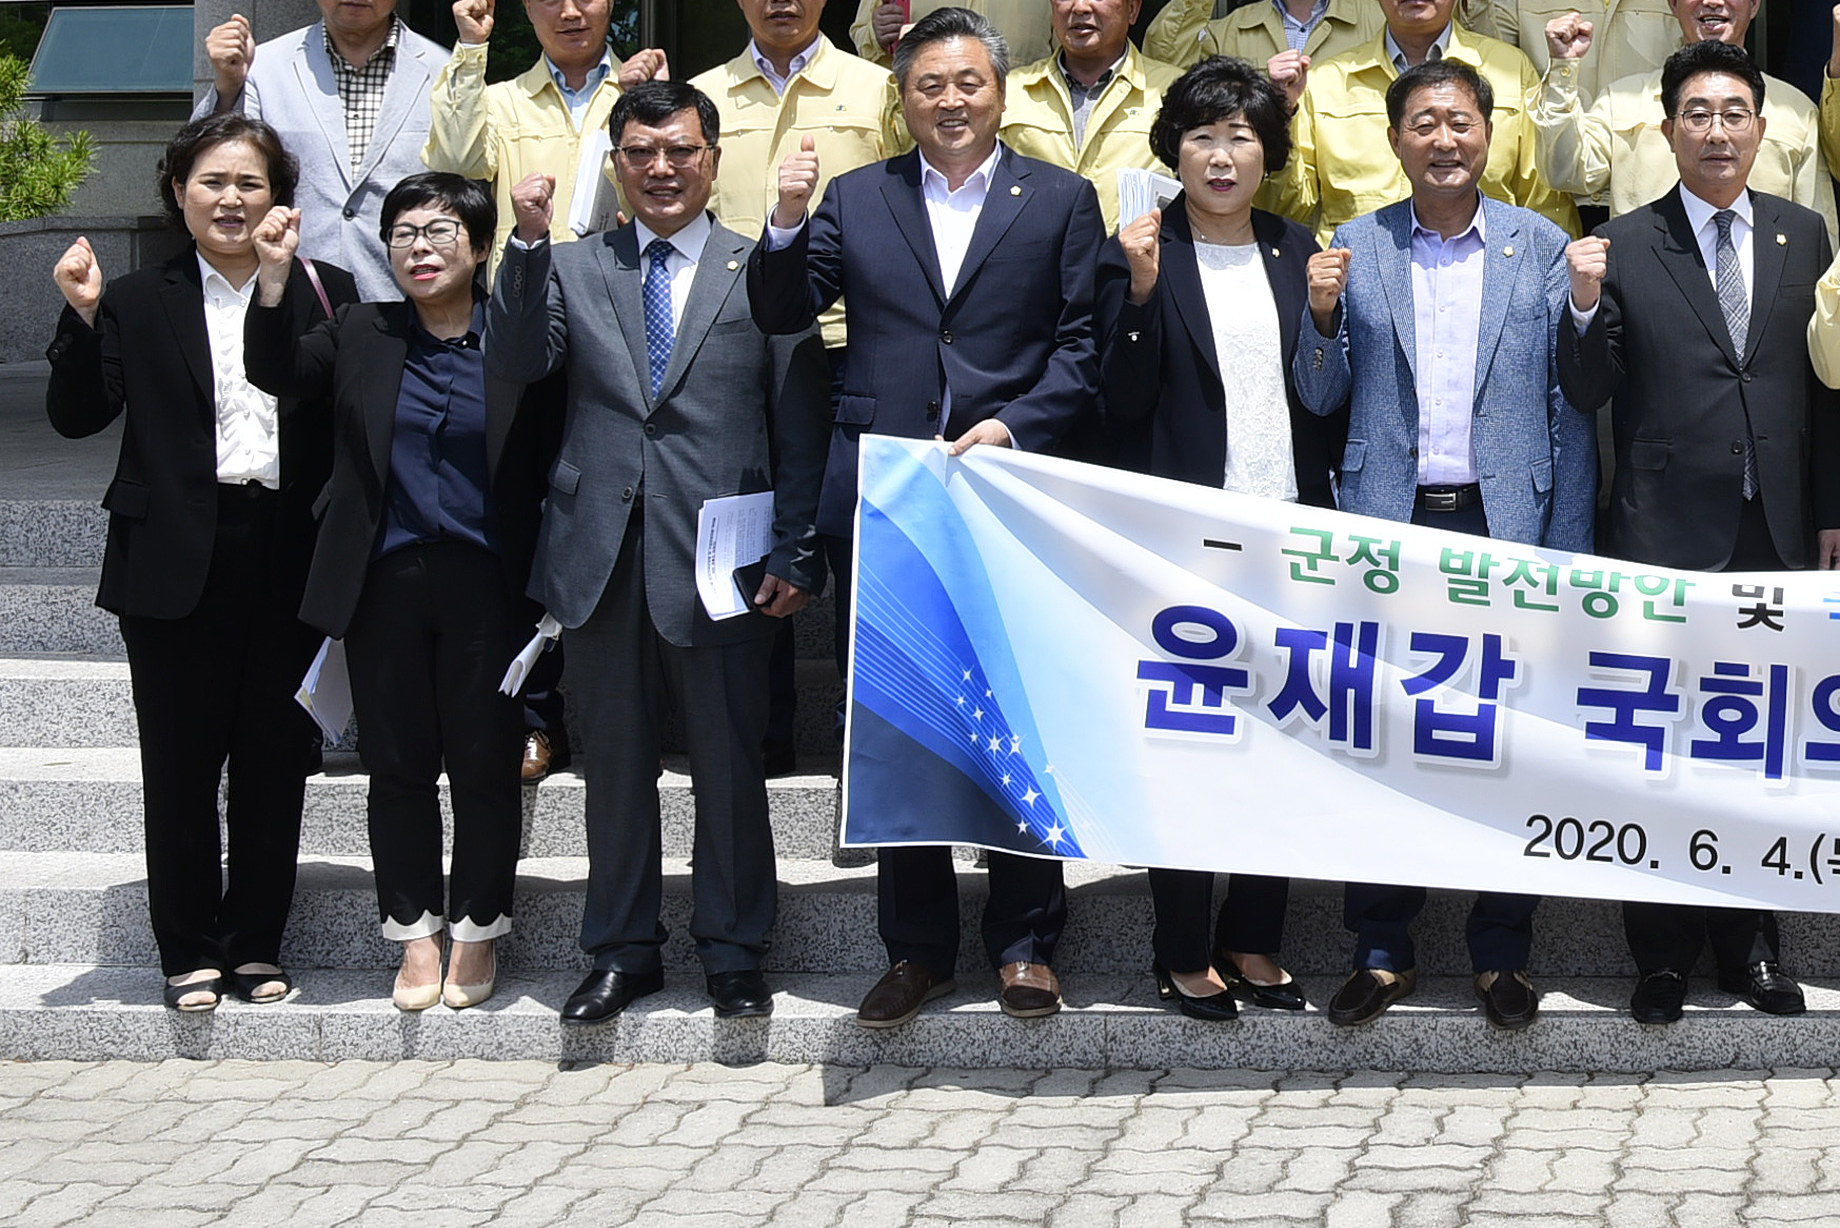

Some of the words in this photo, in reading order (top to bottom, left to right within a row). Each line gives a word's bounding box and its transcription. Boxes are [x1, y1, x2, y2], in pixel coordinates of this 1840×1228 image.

[1281, 526, 1402, 594] 군정
[1438, 547, 1697, 623] 발전방안
[1732, 583, 1785, 632] 및
[1136, 604, 1516, 762] 윤재갑
[1523, 814, 1660, 871] 2020.
[1689, 829, 1732, 876] 6.
